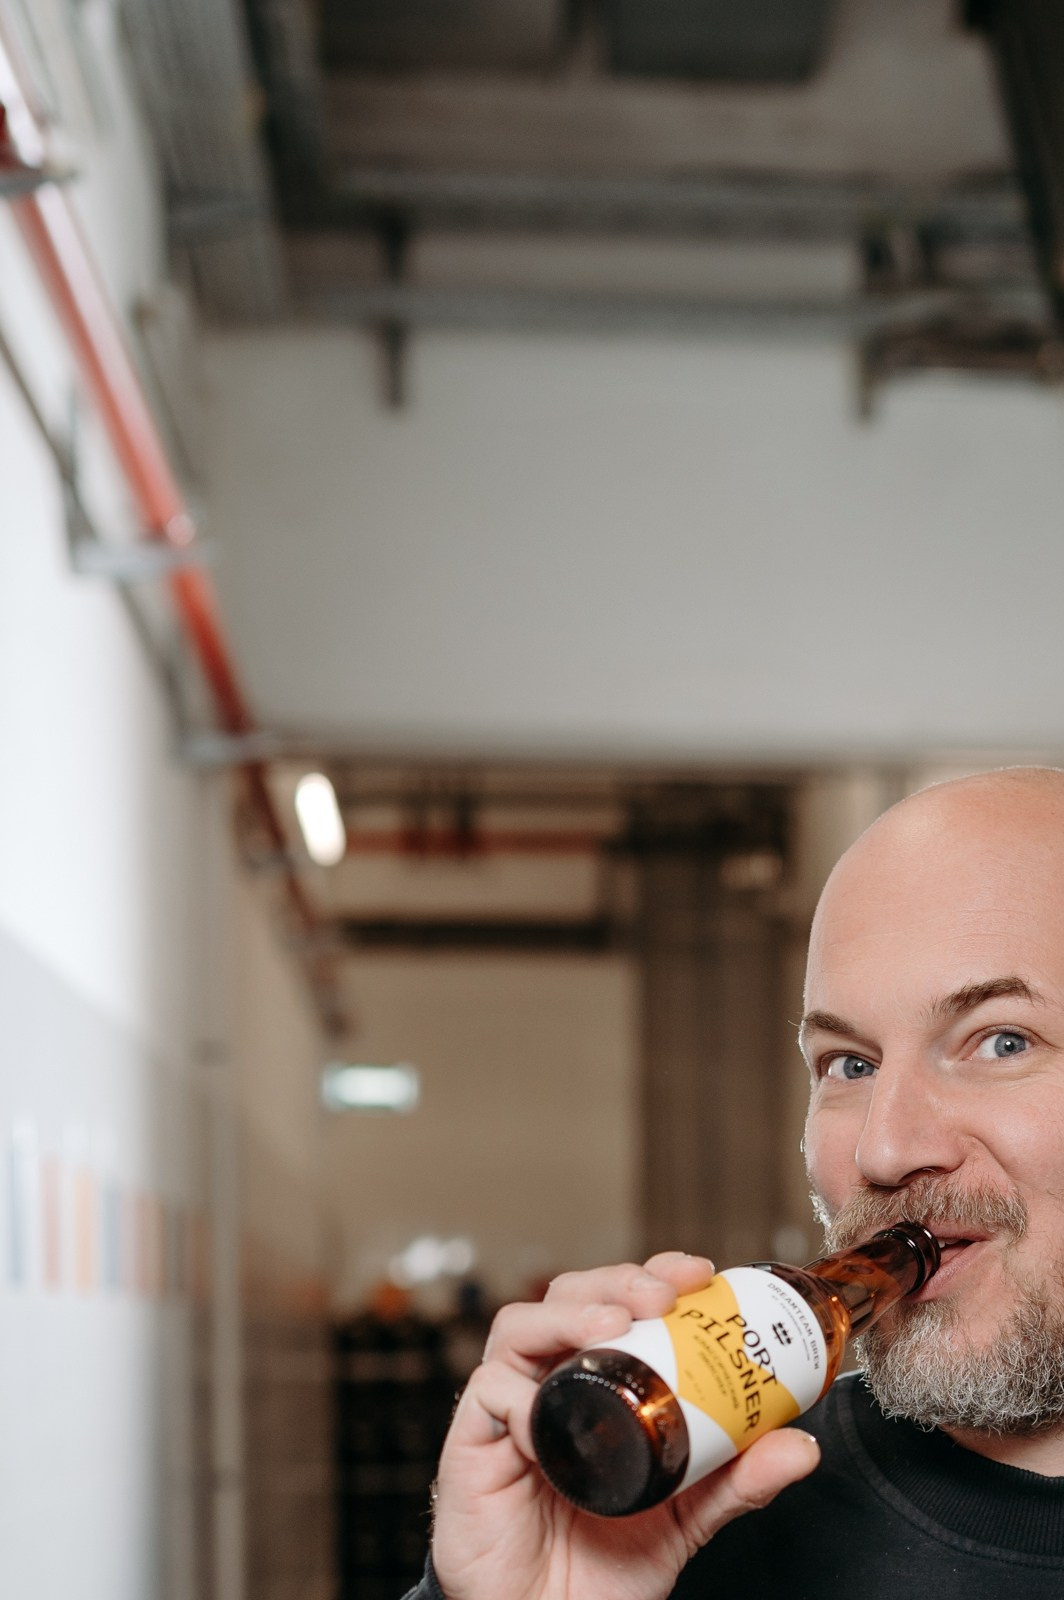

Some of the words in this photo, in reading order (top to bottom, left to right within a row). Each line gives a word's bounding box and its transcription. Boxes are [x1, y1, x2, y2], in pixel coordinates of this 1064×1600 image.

[725, 1313, 777, 1388] PORT
[767, 1283, 813, 1337] DREAMTEAM
[809, 1340, 820, 1370] BREW
[680, 1308, 762, 1433] PILSNER
